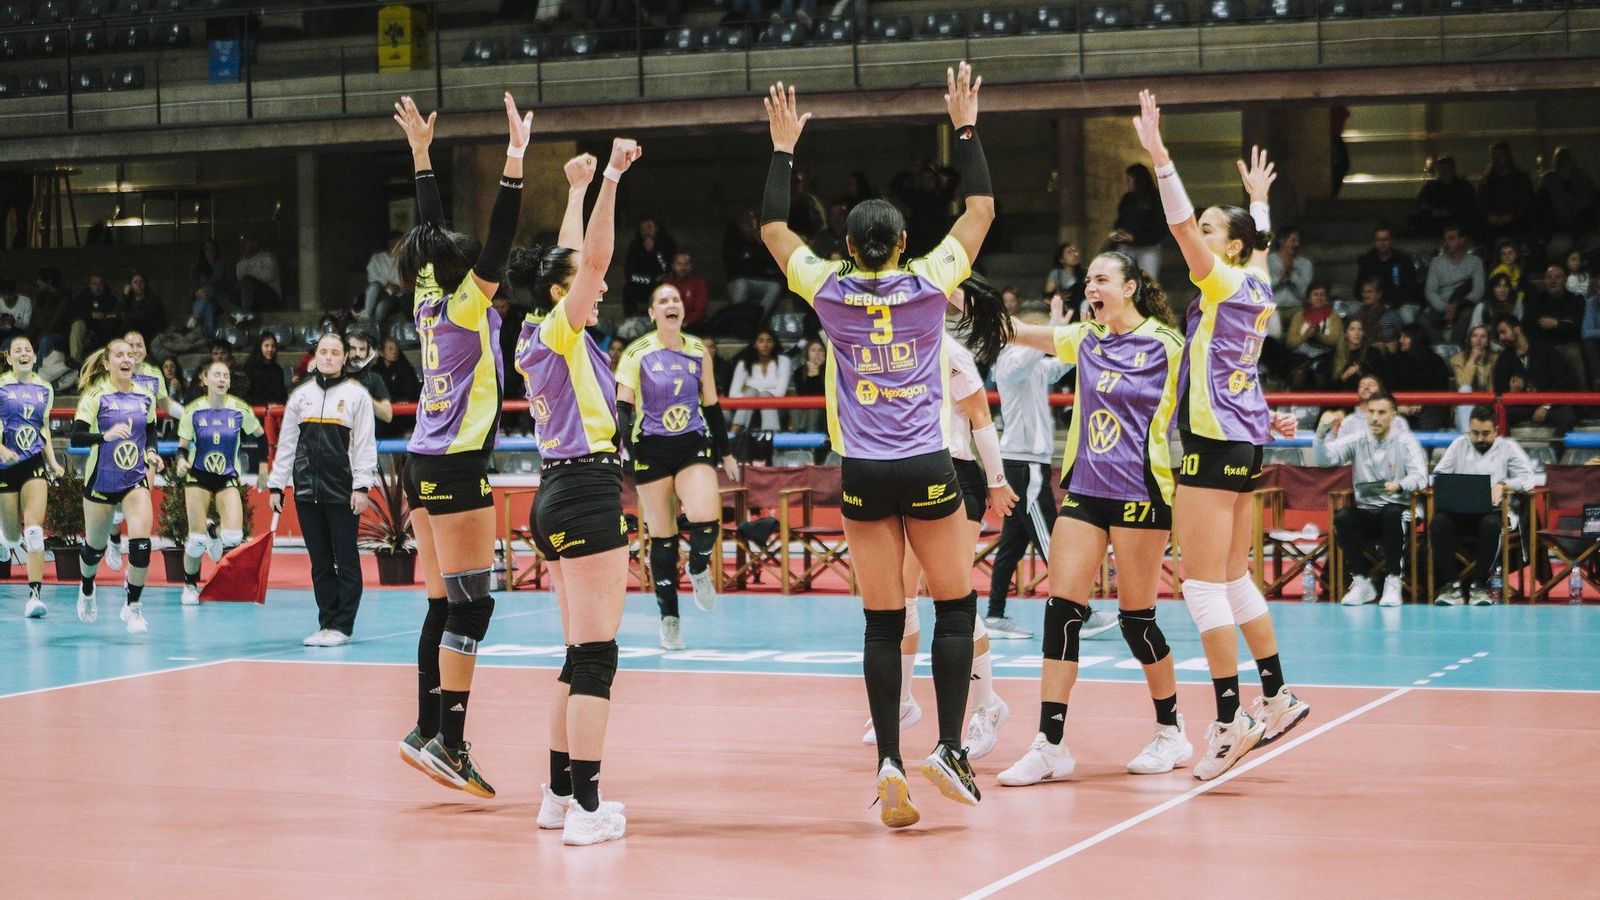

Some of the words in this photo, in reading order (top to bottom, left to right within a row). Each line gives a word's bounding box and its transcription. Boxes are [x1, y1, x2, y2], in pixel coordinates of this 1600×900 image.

[866, 305, 894, 345] 3
[673, 379, 684, 396] 7
[1096, 370, 1121, 393] 27
[880, 384, 926, 402] Hexagon
[23, 405, 34, 420] 17
[213, 431, 220, 445] 8
[1088, 409, 1120, 453] VW
[113, 443, 139, 470] VW
[204, 453, 226, 475] VW
[1124, 502, 1151, 522] 27
[1215, 745, 1231, 759] N
